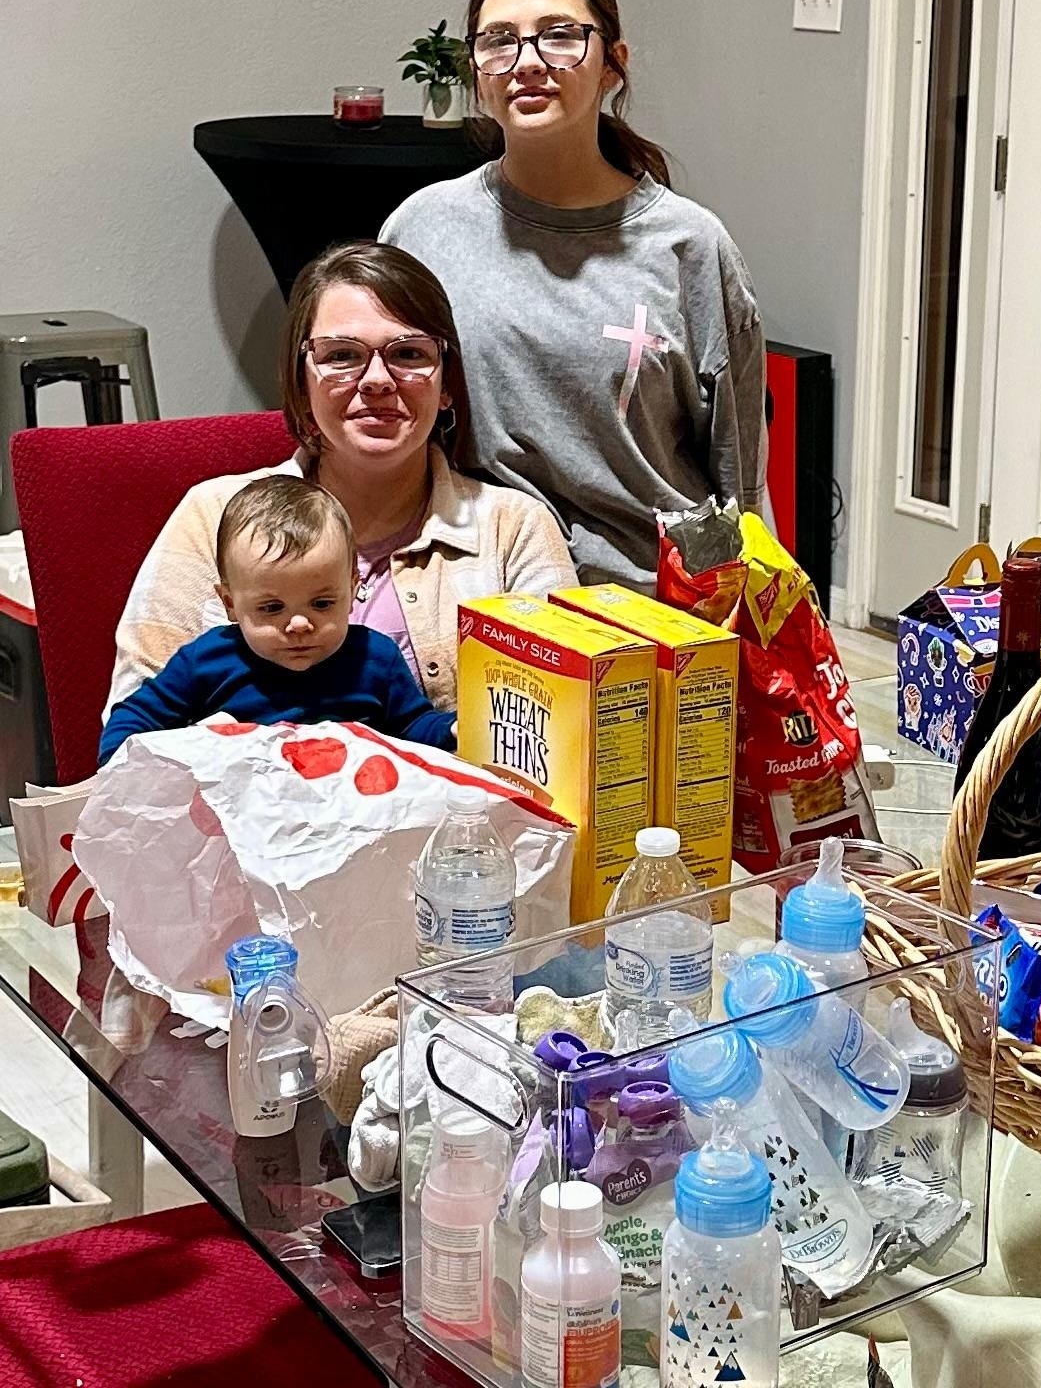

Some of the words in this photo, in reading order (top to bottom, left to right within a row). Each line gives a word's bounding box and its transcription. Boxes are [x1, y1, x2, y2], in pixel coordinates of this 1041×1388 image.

[482, 622, 528, 652] FAMILY
[530, 643, 561, 667] SIZE
[502, 670, 528, 692] WHOLE
[528, 681, 554, 710] GRAIN
[486, 686, 551, 743] WHEAT
[764, 750, 820, 775] Toasted
[607, 1169, 648, 1197] Parent's
[603, 1216, 647, 1237] Apple,
[651, 1228, 664, 1241] &
